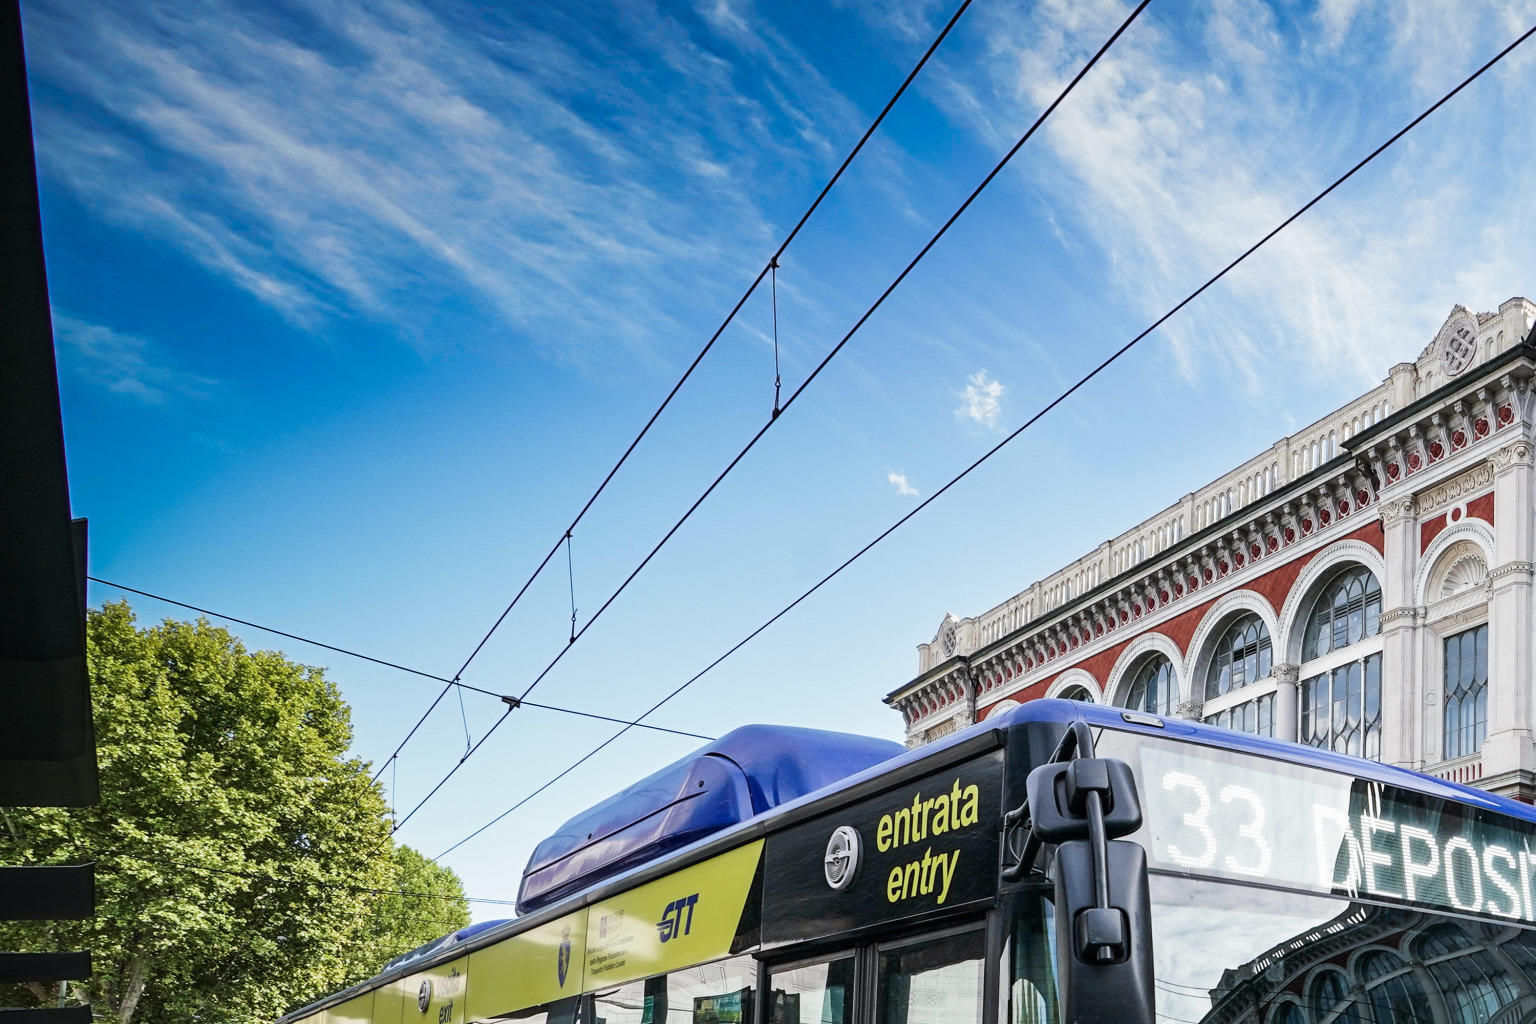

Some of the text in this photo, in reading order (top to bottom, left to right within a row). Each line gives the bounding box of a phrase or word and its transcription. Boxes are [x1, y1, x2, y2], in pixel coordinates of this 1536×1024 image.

[876, 777, 979, 853] entrata
[1162, 770, 1271, 878] 33
[887, 846, 960, 905] entry
[656, 893, 699, 943] GTT
